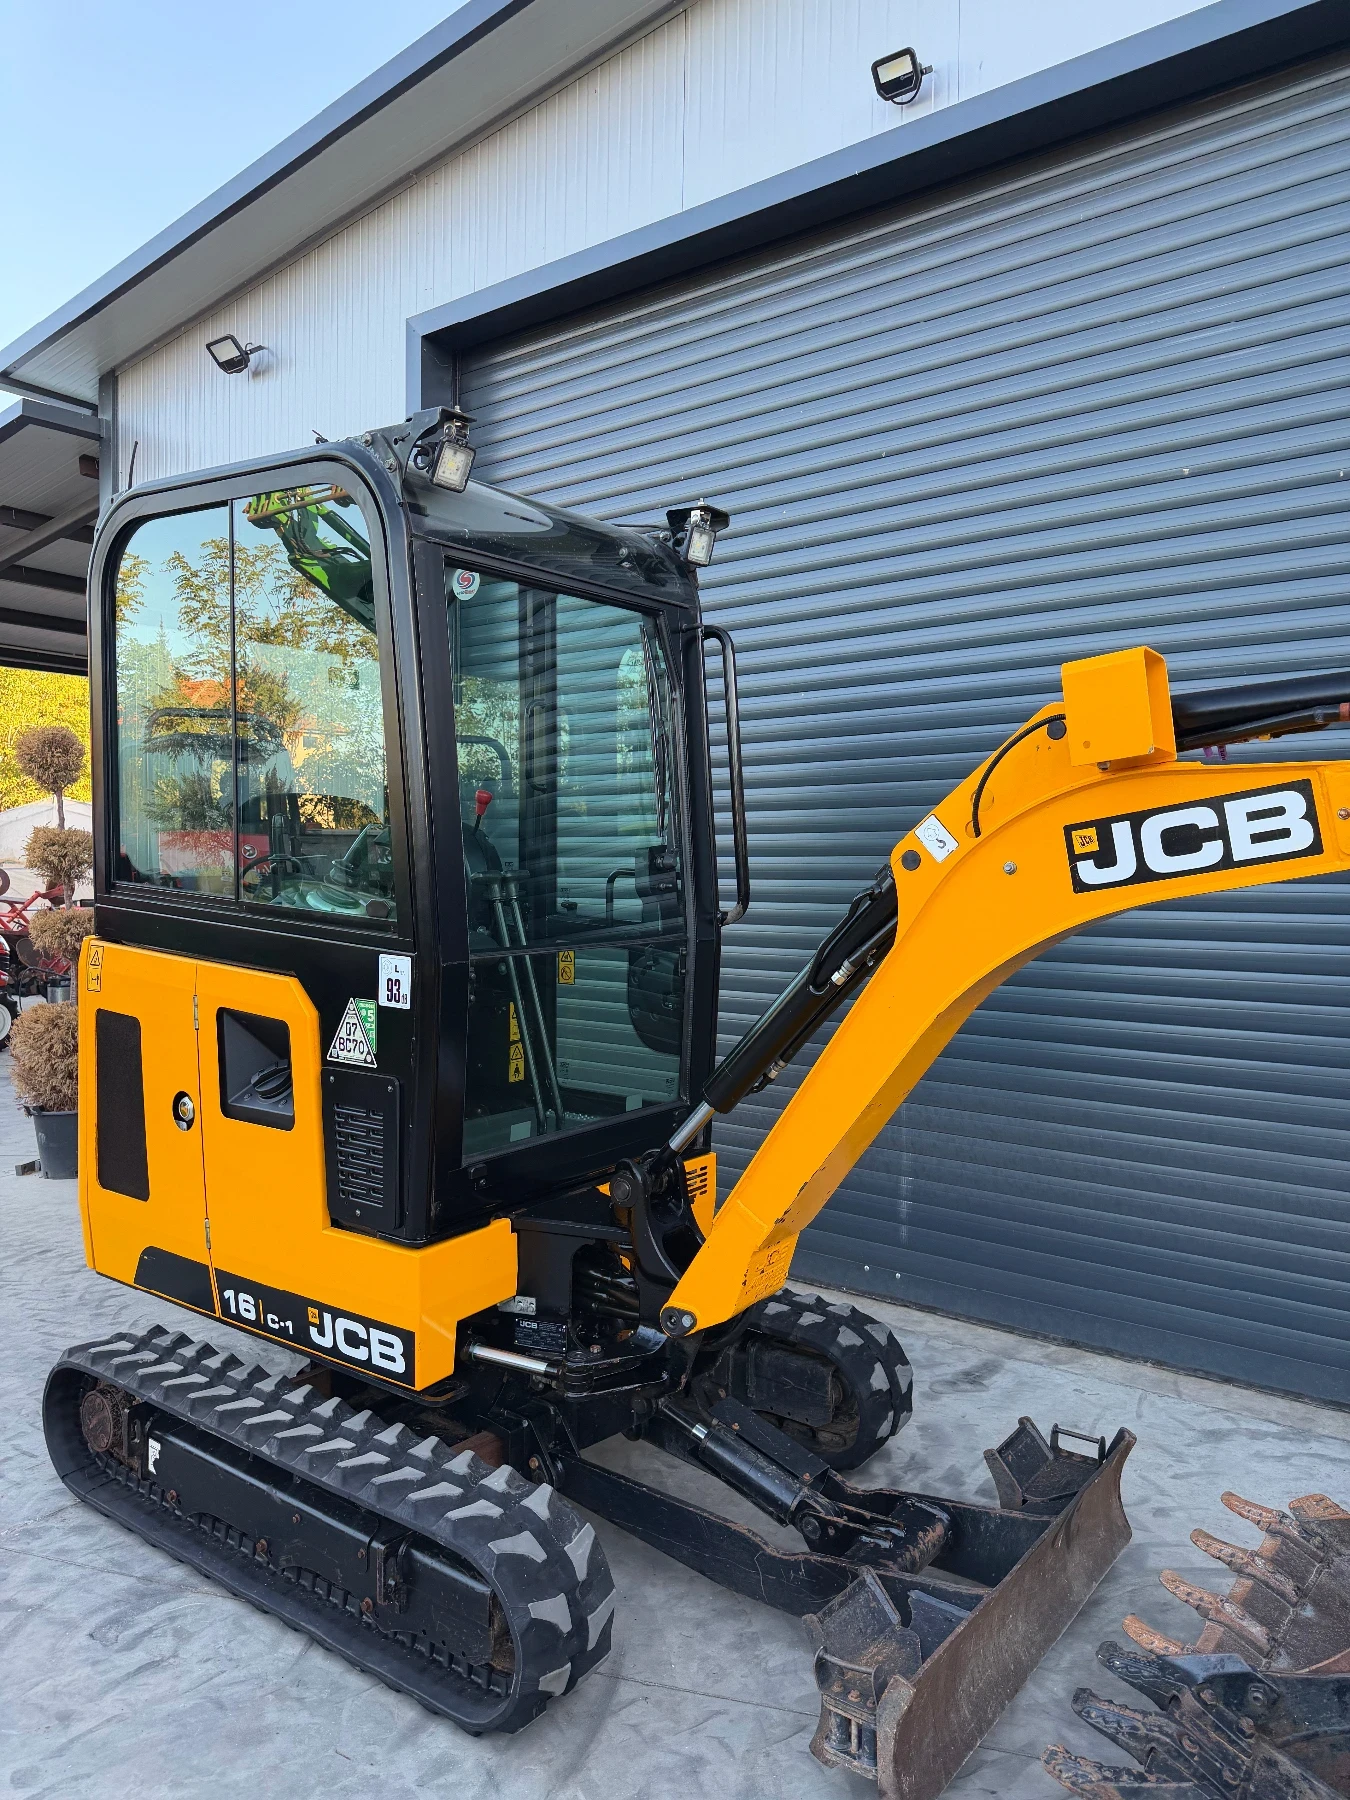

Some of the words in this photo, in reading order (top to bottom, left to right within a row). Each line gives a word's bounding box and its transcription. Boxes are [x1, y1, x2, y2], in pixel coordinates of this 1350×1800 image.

[1077, 790, 1314, 885] JCB
[1079, 835, 1094, 847] JCB
[386, 978, 400, 1003] 93
[223, 1289, 256, 1321] 16
[520, 1321, 538, 1329] JCB
[309, 1312, 406, 1374] JCB
